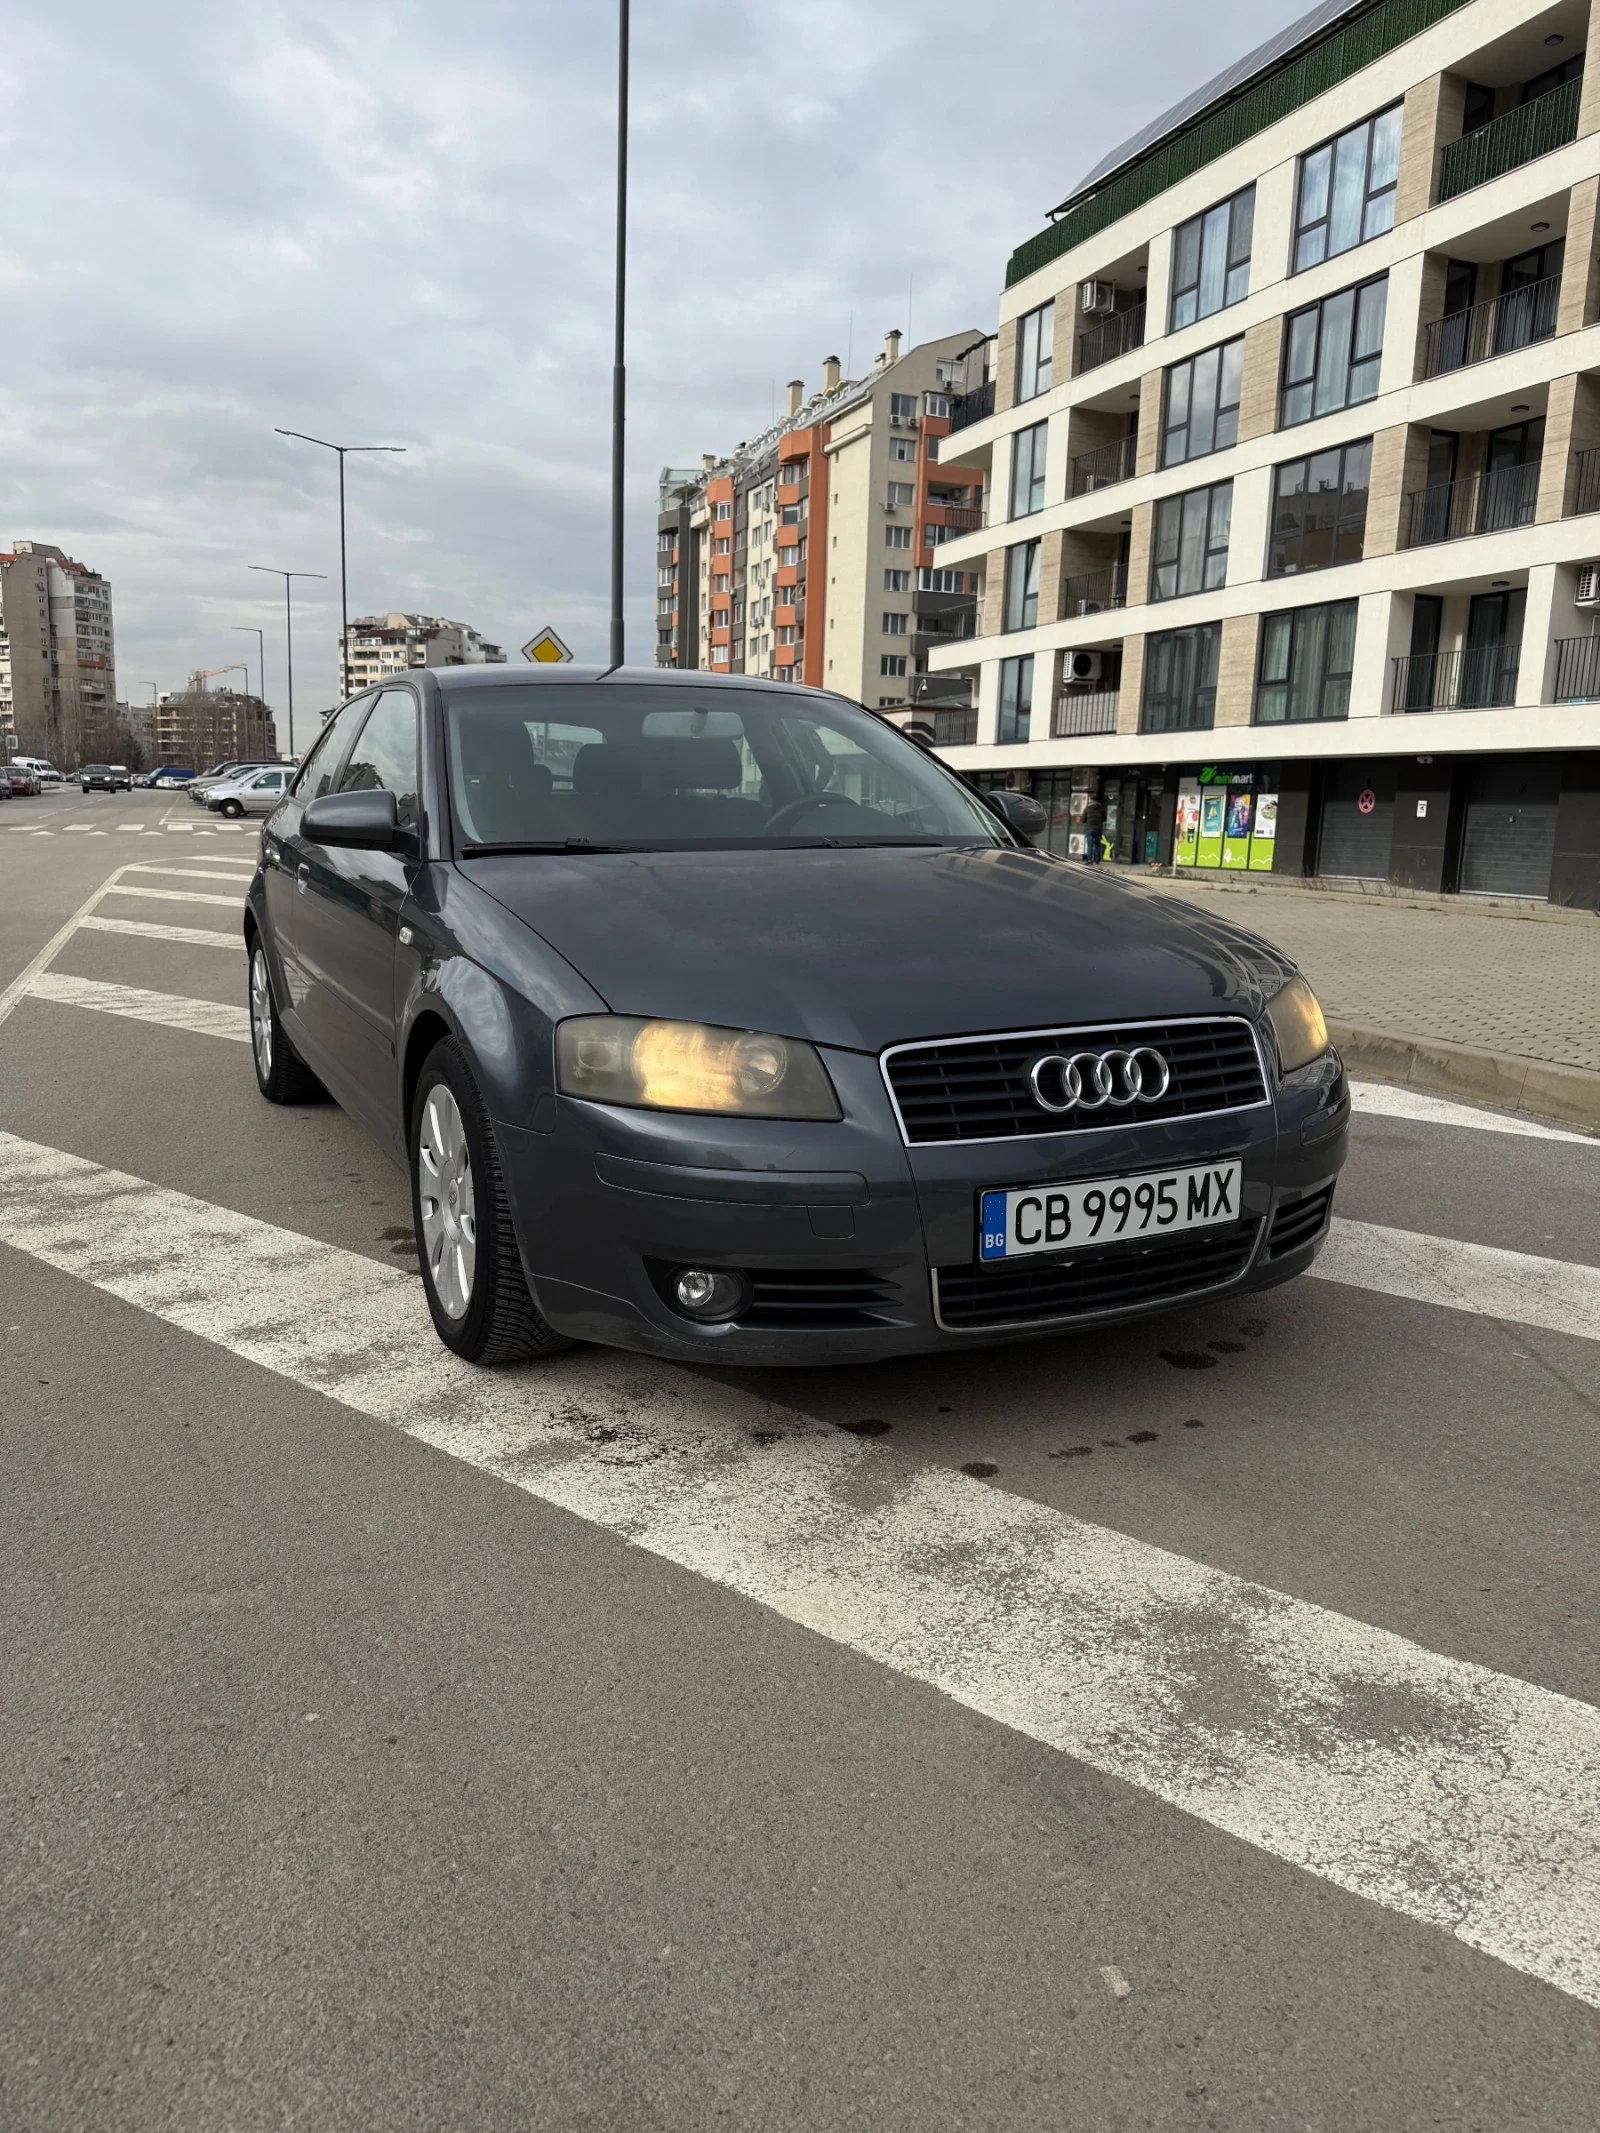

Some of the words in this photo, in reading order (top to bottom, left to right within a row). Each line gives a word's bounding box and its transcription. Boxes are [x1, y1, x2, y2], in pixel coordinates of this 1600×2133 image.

[1214, 772, 1254, 785] minimart
[1015, 1193, 1072, 1245] CB
[1083, 1178, 1178, 1237] 9995
[1187, 1168, 1234, 1221] MX
[985, 1233, 1004, 1249] BG
